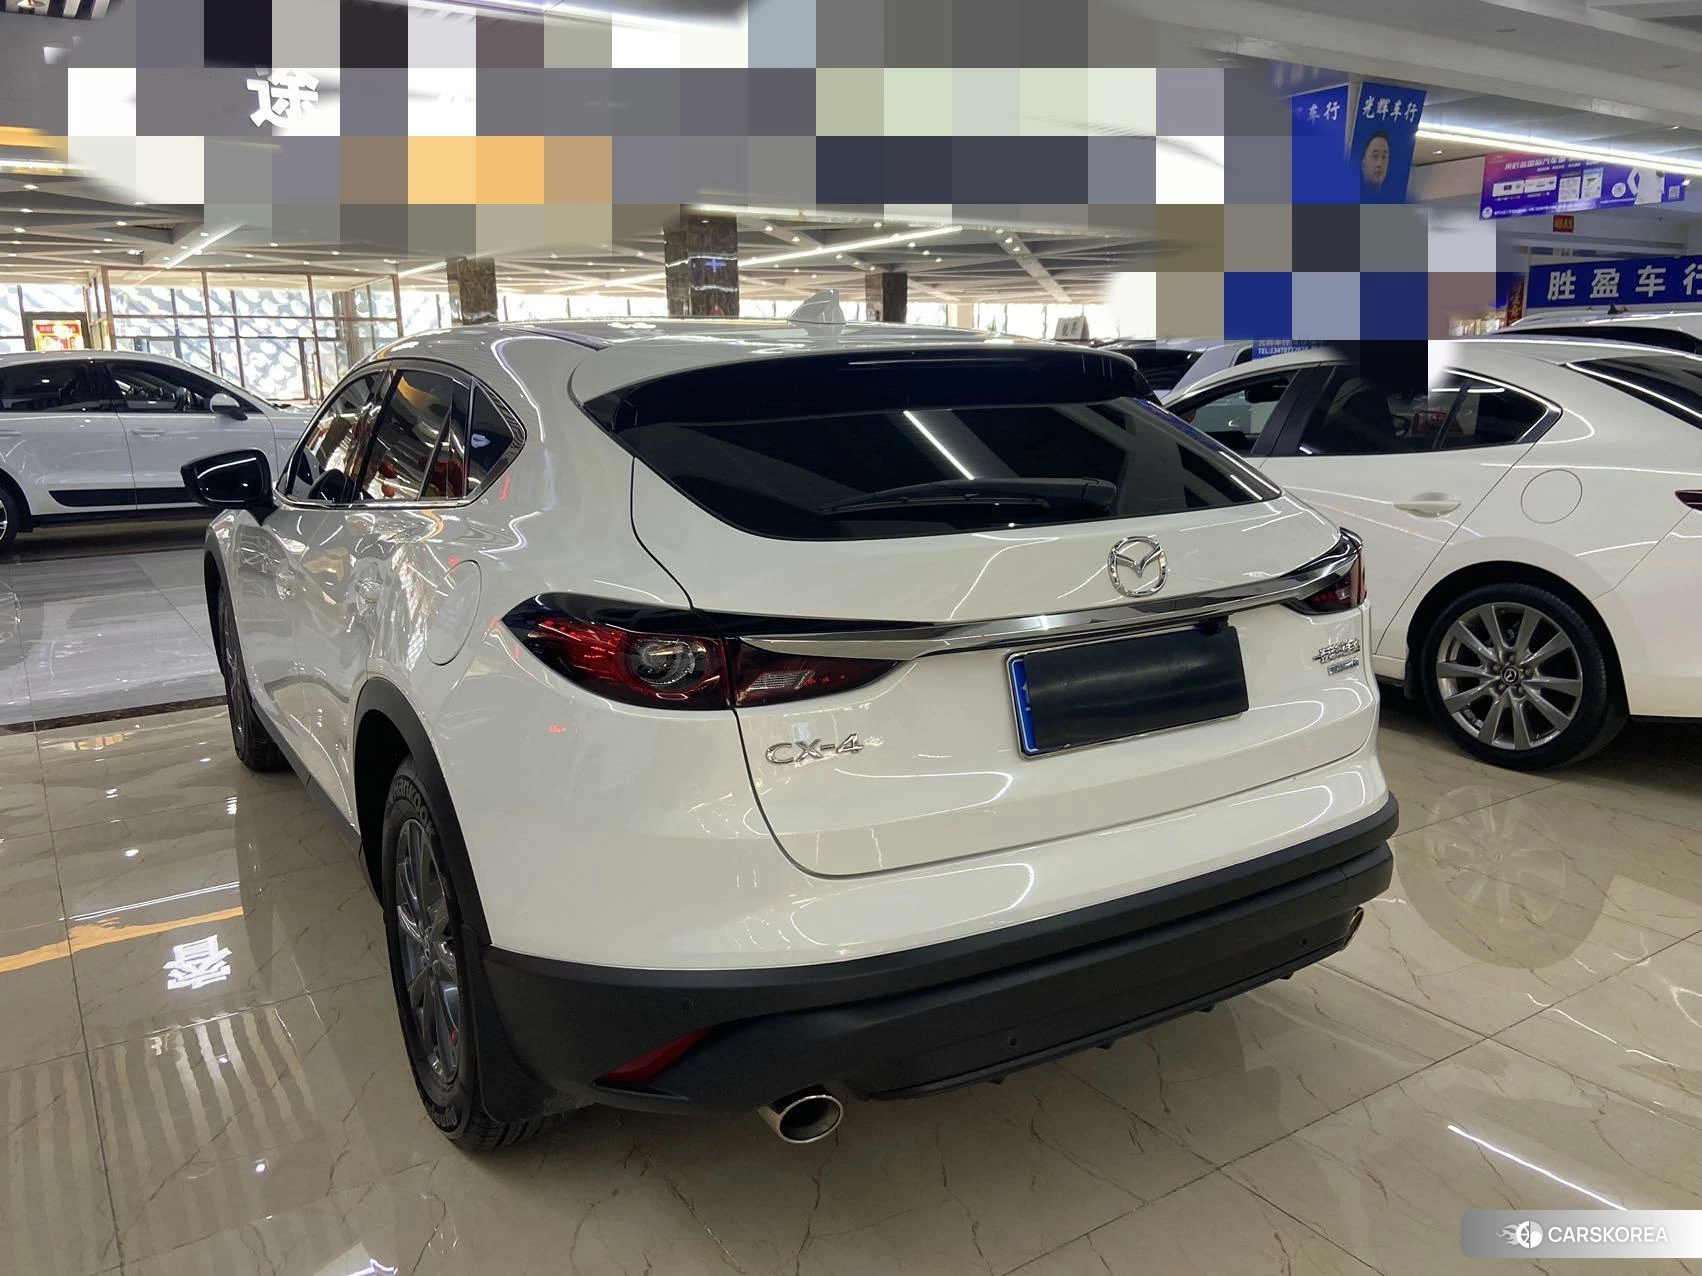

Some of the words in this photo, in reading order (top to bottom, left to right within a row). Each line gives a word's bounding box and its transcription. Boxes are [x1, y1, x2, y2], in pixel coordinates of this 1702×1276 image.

[1362, 96, 1418, 123] 光辉车行
[1547, 263, 1702, 301] 胜盈车行
[765, 733, 864, 764] CX-4
